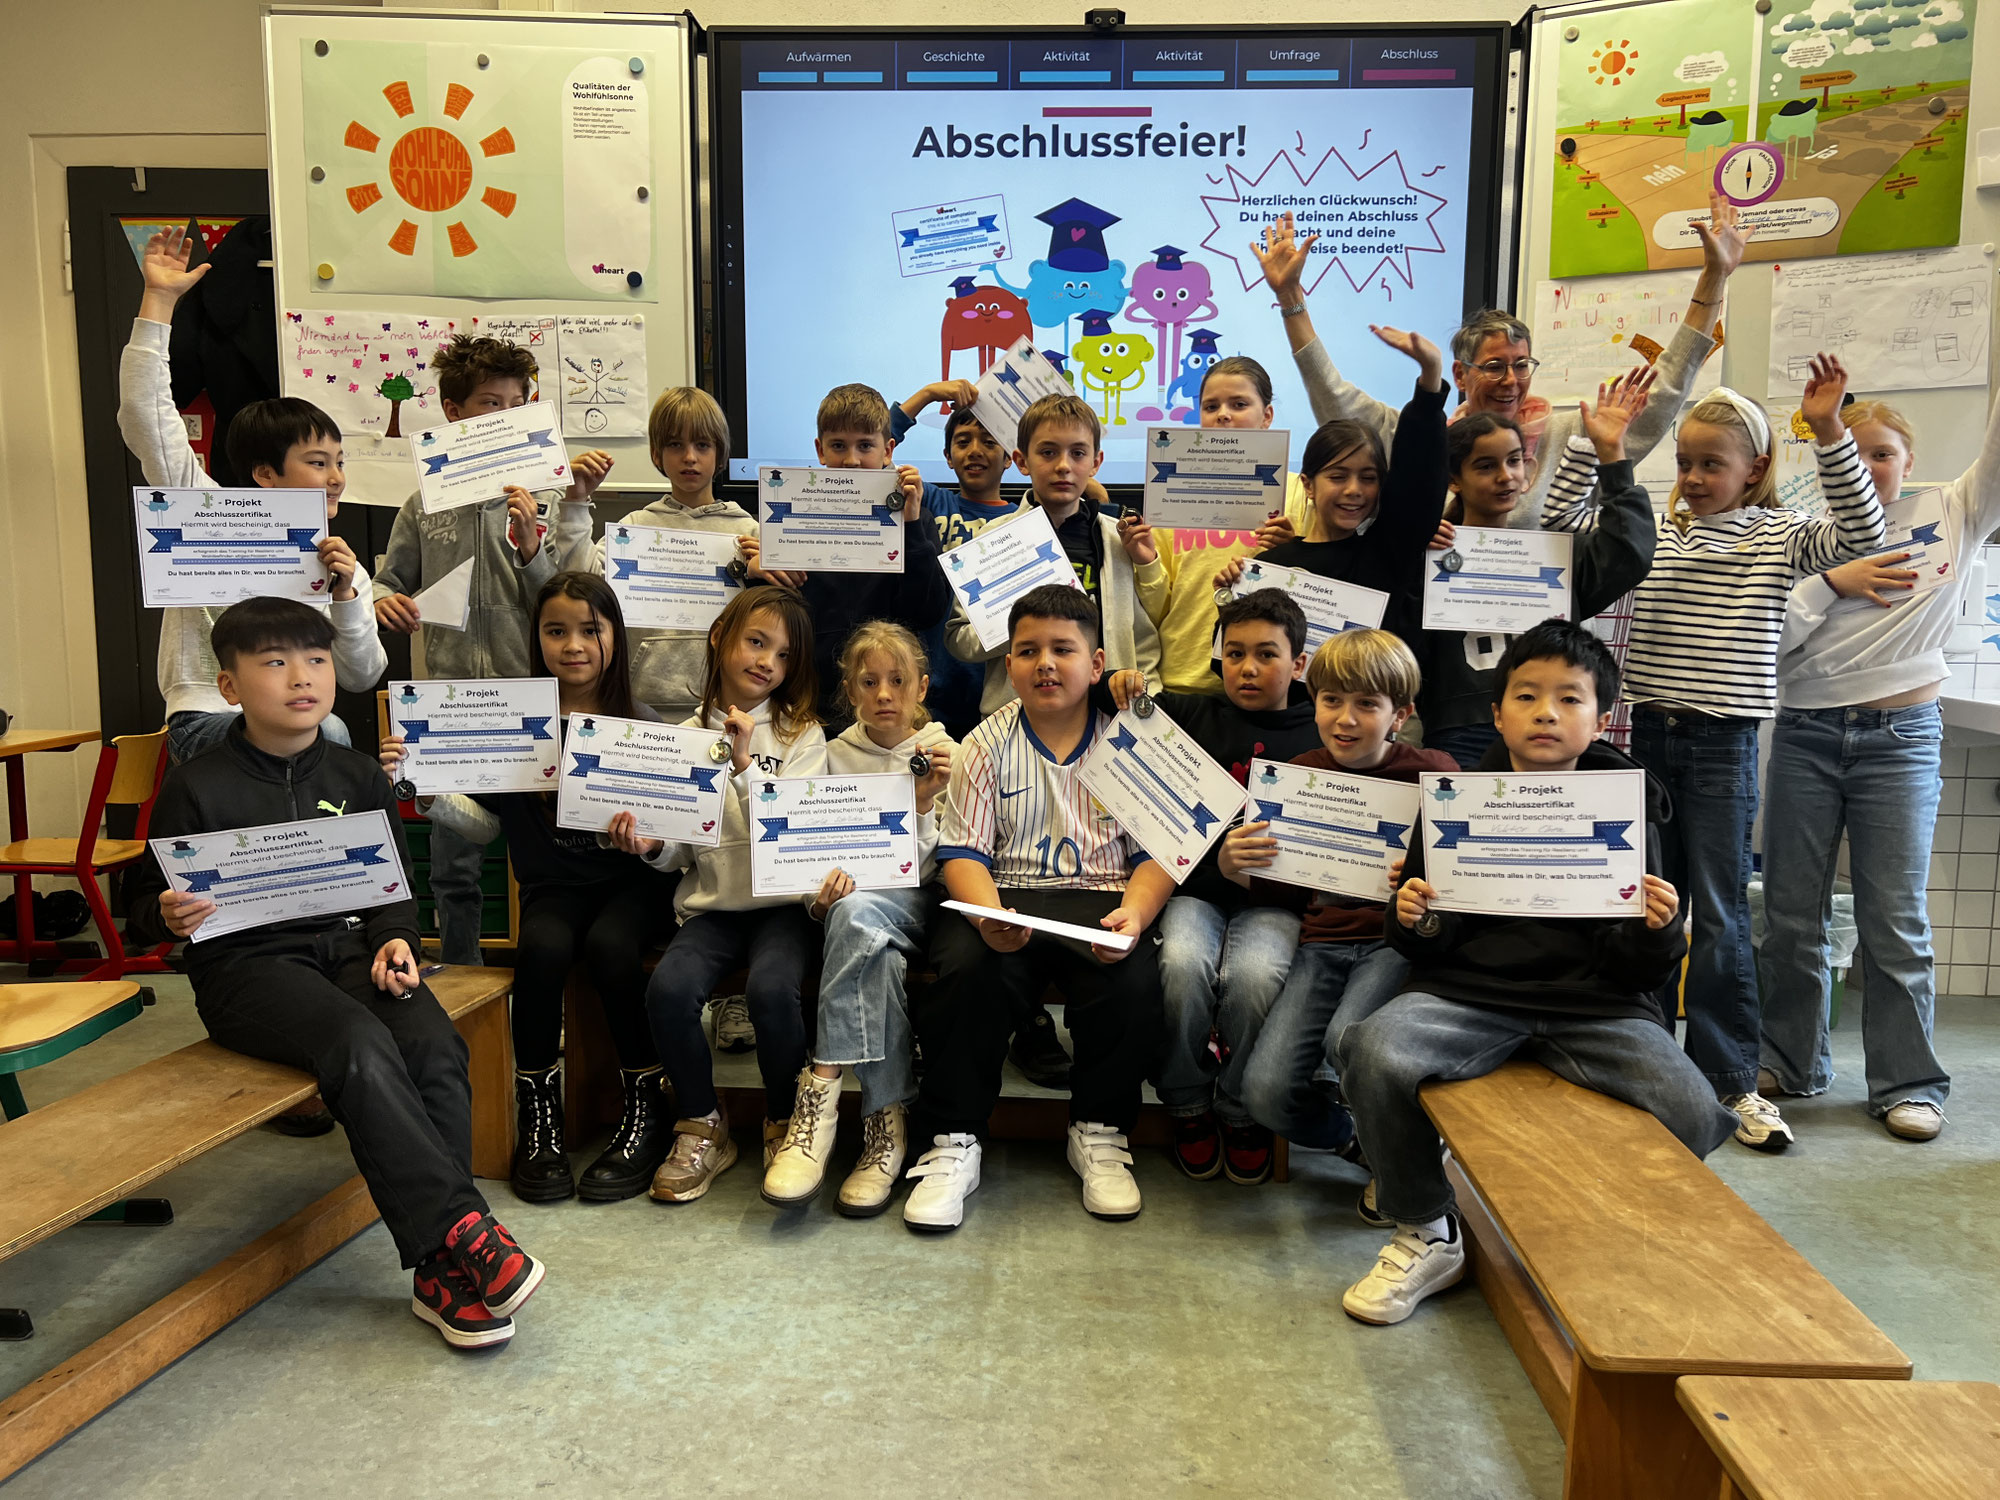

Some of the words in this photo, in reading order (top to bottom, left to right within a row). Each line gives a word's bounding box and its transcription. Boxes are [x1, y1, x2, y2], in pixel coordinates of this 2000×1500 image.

[786, 49, 852, 61] Aufwärmen
[923, 49, 985, 62] Geschichte
[1043, 49, 1090, 61] Aktivität
[1155, 48, 1203, 61] Aktivität
[1269, 48, 1321, 63] Umfrage
[1380, 47, 1439, 60] Abschluss
[572, 82, 615, 91] Qualitäten
[572, 91, 634, 100] Wohlfühlsonne
[912, 122, 1247, 159] Abschlussfeier!
[391, 127, 473, 171] WOHLFÜHL
[1642, 164, 1687, 186] nein
[392, 168, 473, 212] SONNE
[1241, 195, 1316, 206] Herzlichen
[1319, 194, 1418, 206] Glückwunsch!
[1239, 211, 1259, 222] Du
[1262, 211, 1291, 222] has
[1296, 211, 1344, 222] deinen
[1347, 211, 1419, 222] Abschluss
[1326, 227, 1353, 238] und
[1357, 227, 1396, 238] deine
[1342, 243, 1404, 254] beendet!
[295, 325, 350, 343] Niemand
[476, 419, 505, 430] Projekt
[1211, 438, 1239, 446] Projekt
[825, 478, 853, 486] Projekt
[225, 499, 262, 508] Projekt
[229, 521, 273, 529] bescheinigt,
[670, 537, 698, 547] Projekt
[989, 533, 1013, 548] Projekt
[1494, 538, 1522, 547] Projekt
[648, 546, 705, 556] Abschlusszertifikat
[1303, 583, 1334, 597] Projekt
[466, 689, 499, 699] Projekt
[471, 711, 509, 719] bescheinigt,
[643, 732, 675, 744] Projekt
[614, 741, 681, 754] Abschlusszertifikat
[1152, 735, 1200, 783] Abschlusszertifikat
[1176, 743, 1202, 770] Projekt
[826, 785, 858, 794] Projekt
[1326, 781, 1360, 795] Projekt
[1519, 785, 1563, 796] Projekt
[799, 796, 866, 805] Abschlusszertifikat
[1296, 789, 1367, 807] Abschlusszertifikat
[1484, 800, 1575, 808] Abschlusszertifikat
[829, 806, 867, 815] bescheinigt,
[1523, 813, 1576, 822] bescheinigt,
[263, 830, 310, 844] Projekt
[229, 839, 324, 857] Abschlusszertifikat
[1035, 834, 1082, 877] 10
[1507, 871, 1524, 879] alles
[1535, 872, 1548, 880] Dir,
[1567, 872, 1577, 880] Du
[1579, 872, 1614, 880] brauchst.
